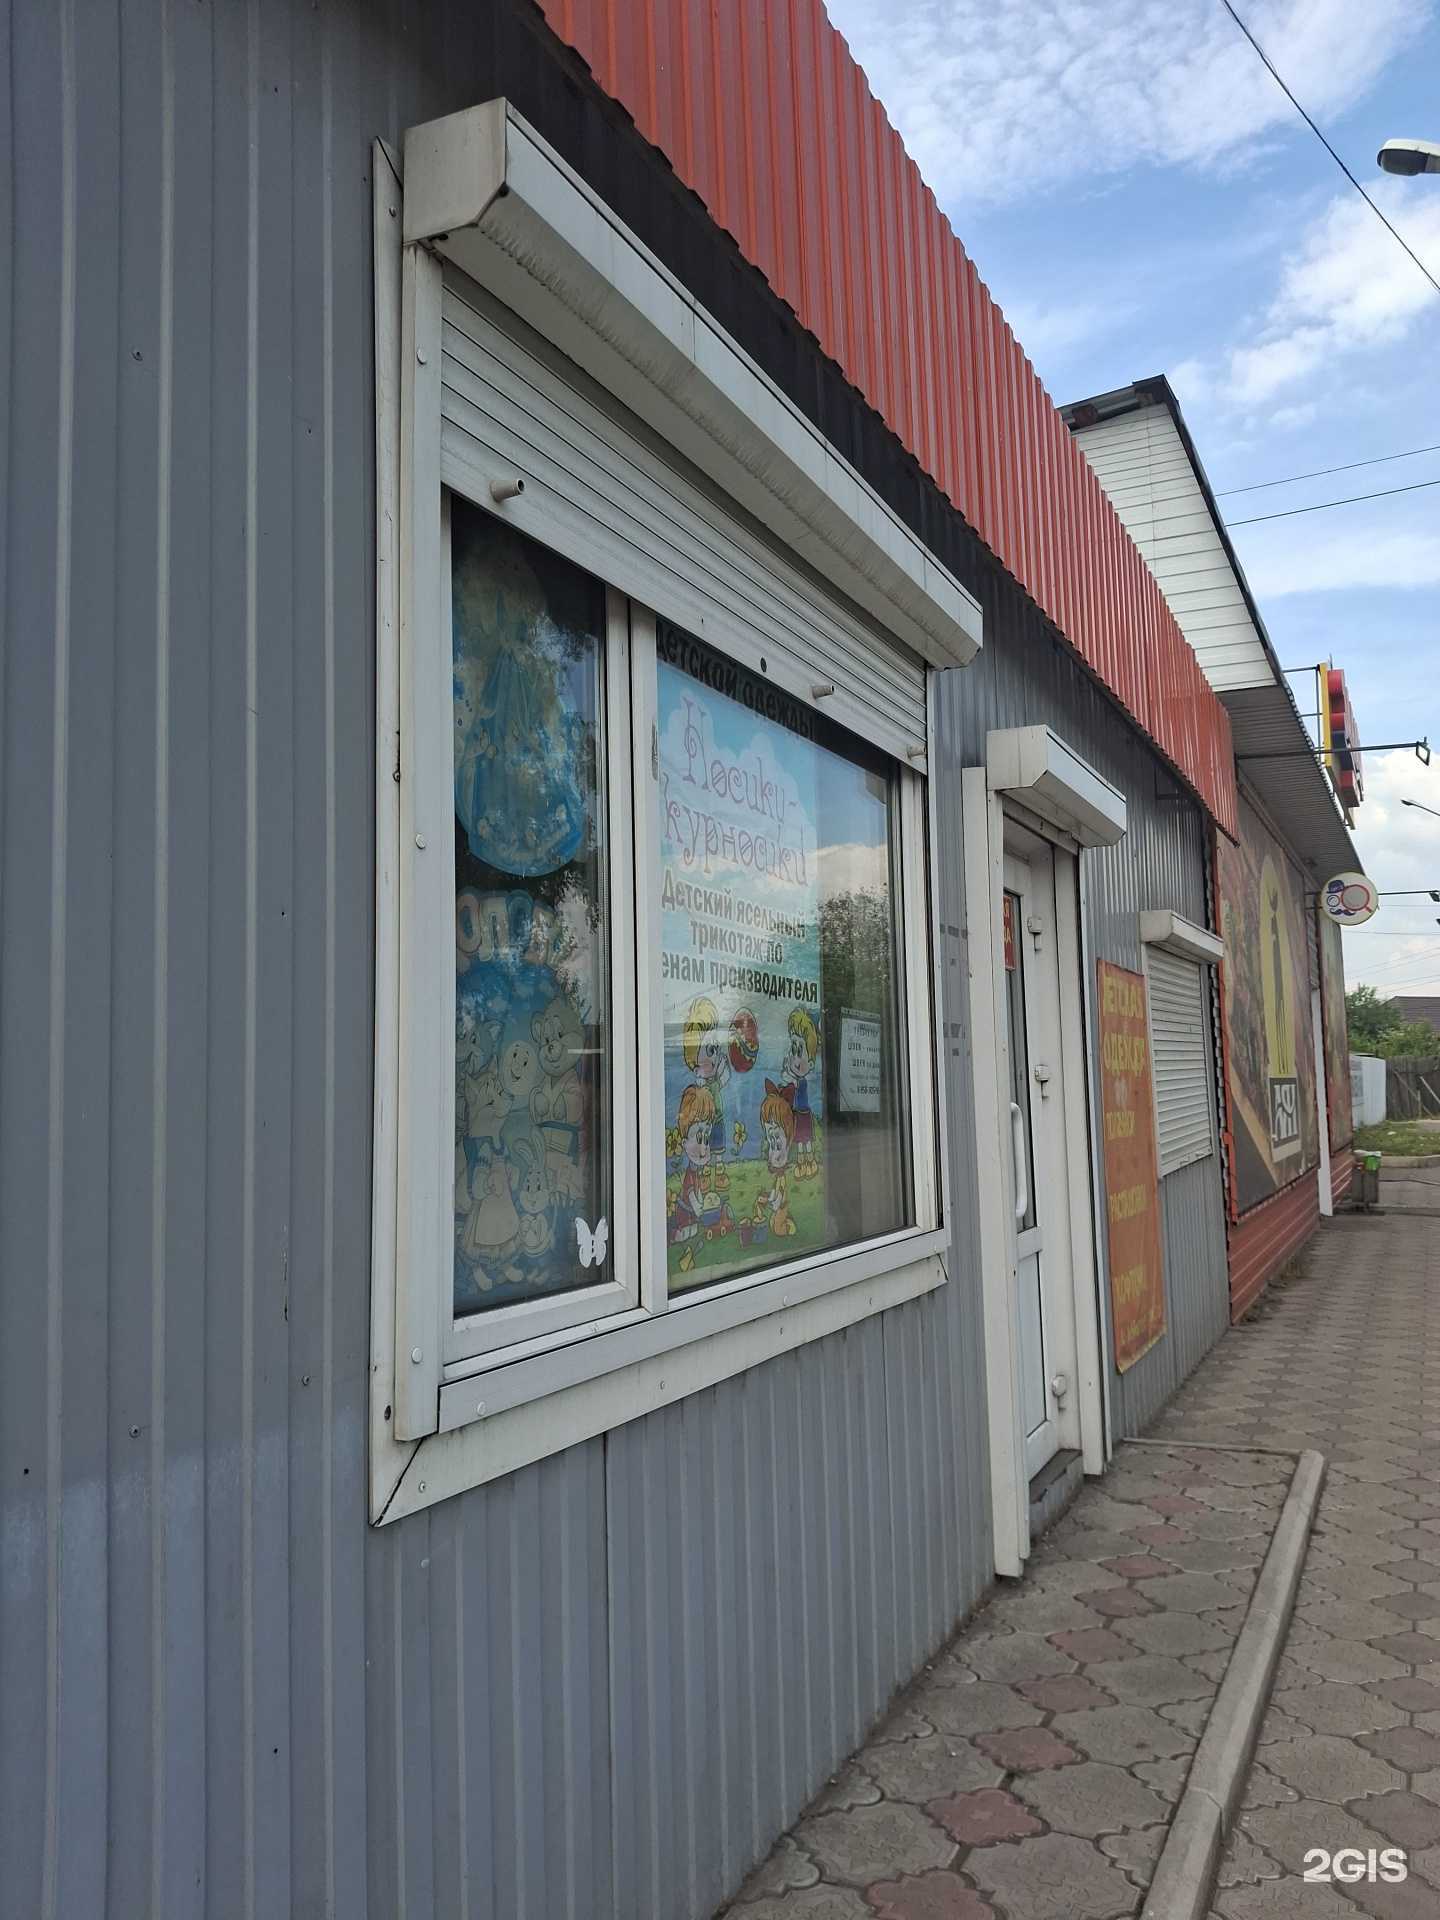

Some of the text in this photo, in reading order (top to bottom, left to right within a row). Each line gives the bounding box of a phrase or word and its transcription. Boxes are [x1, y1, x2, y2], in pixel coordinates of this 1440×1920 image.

[662, 869, 806, 940] Детский ясельный
[690, 919, 783, 964] трикотаж по
[710, 960, 818, 1003] производителя
